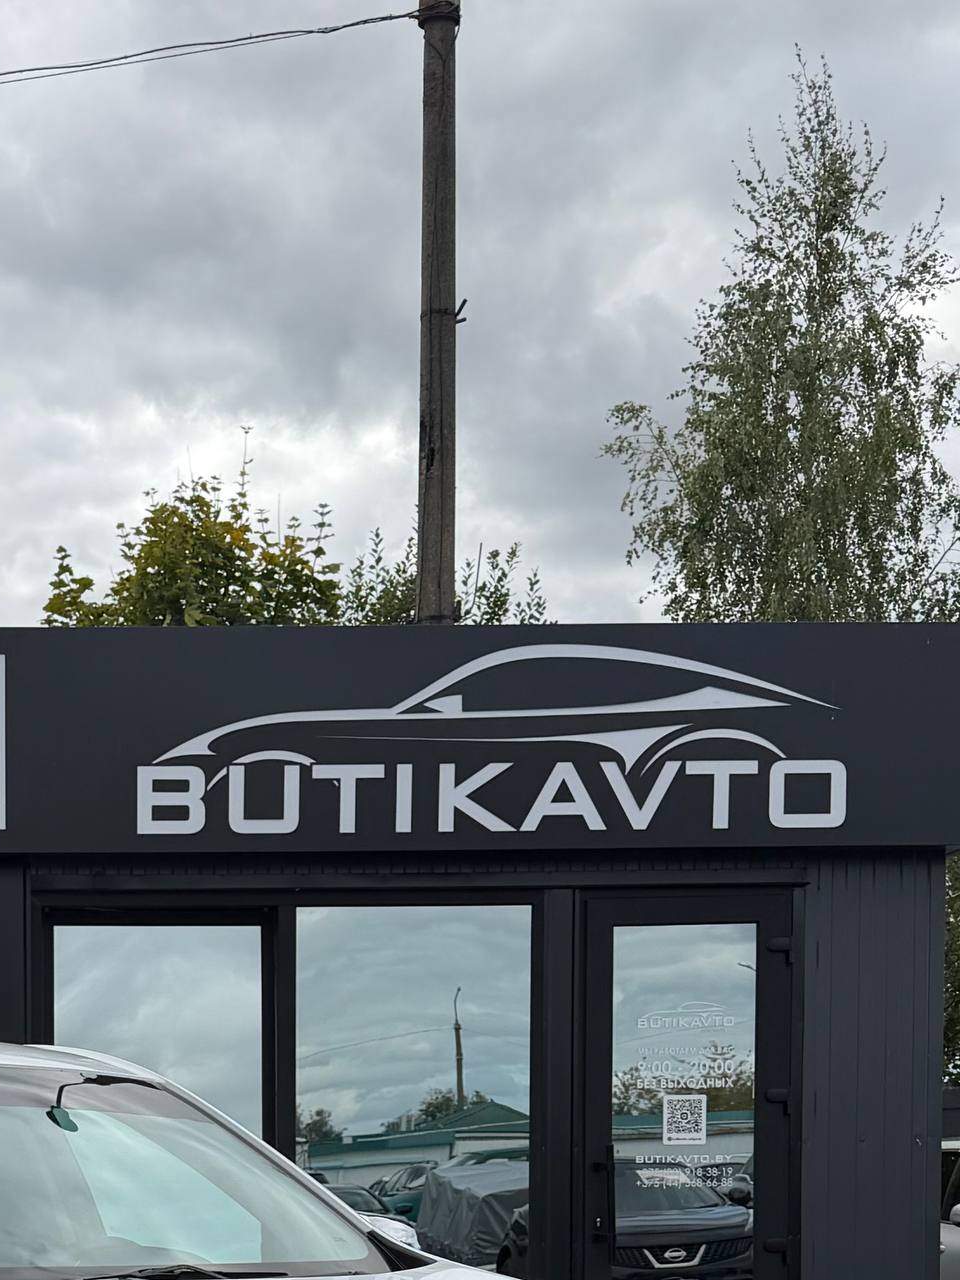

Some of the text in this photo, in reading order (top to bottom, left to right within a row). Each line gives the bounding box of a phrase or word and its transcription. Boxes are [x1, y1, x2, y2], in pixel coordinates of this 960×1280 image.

[137, 759, 848, 835] BUTIKAVTO
[637, 1016, 735, 1029] BUTIKAVTO
[637, 1060, 672, 1075] 9:00
[689, 1059, 735, 1075] 20:00
[636, 1077, 735, 1089] БЕЗ ВЫХОДНЫХ
[635, 1154, 734, 1164] BUTIKAVTO.BY
